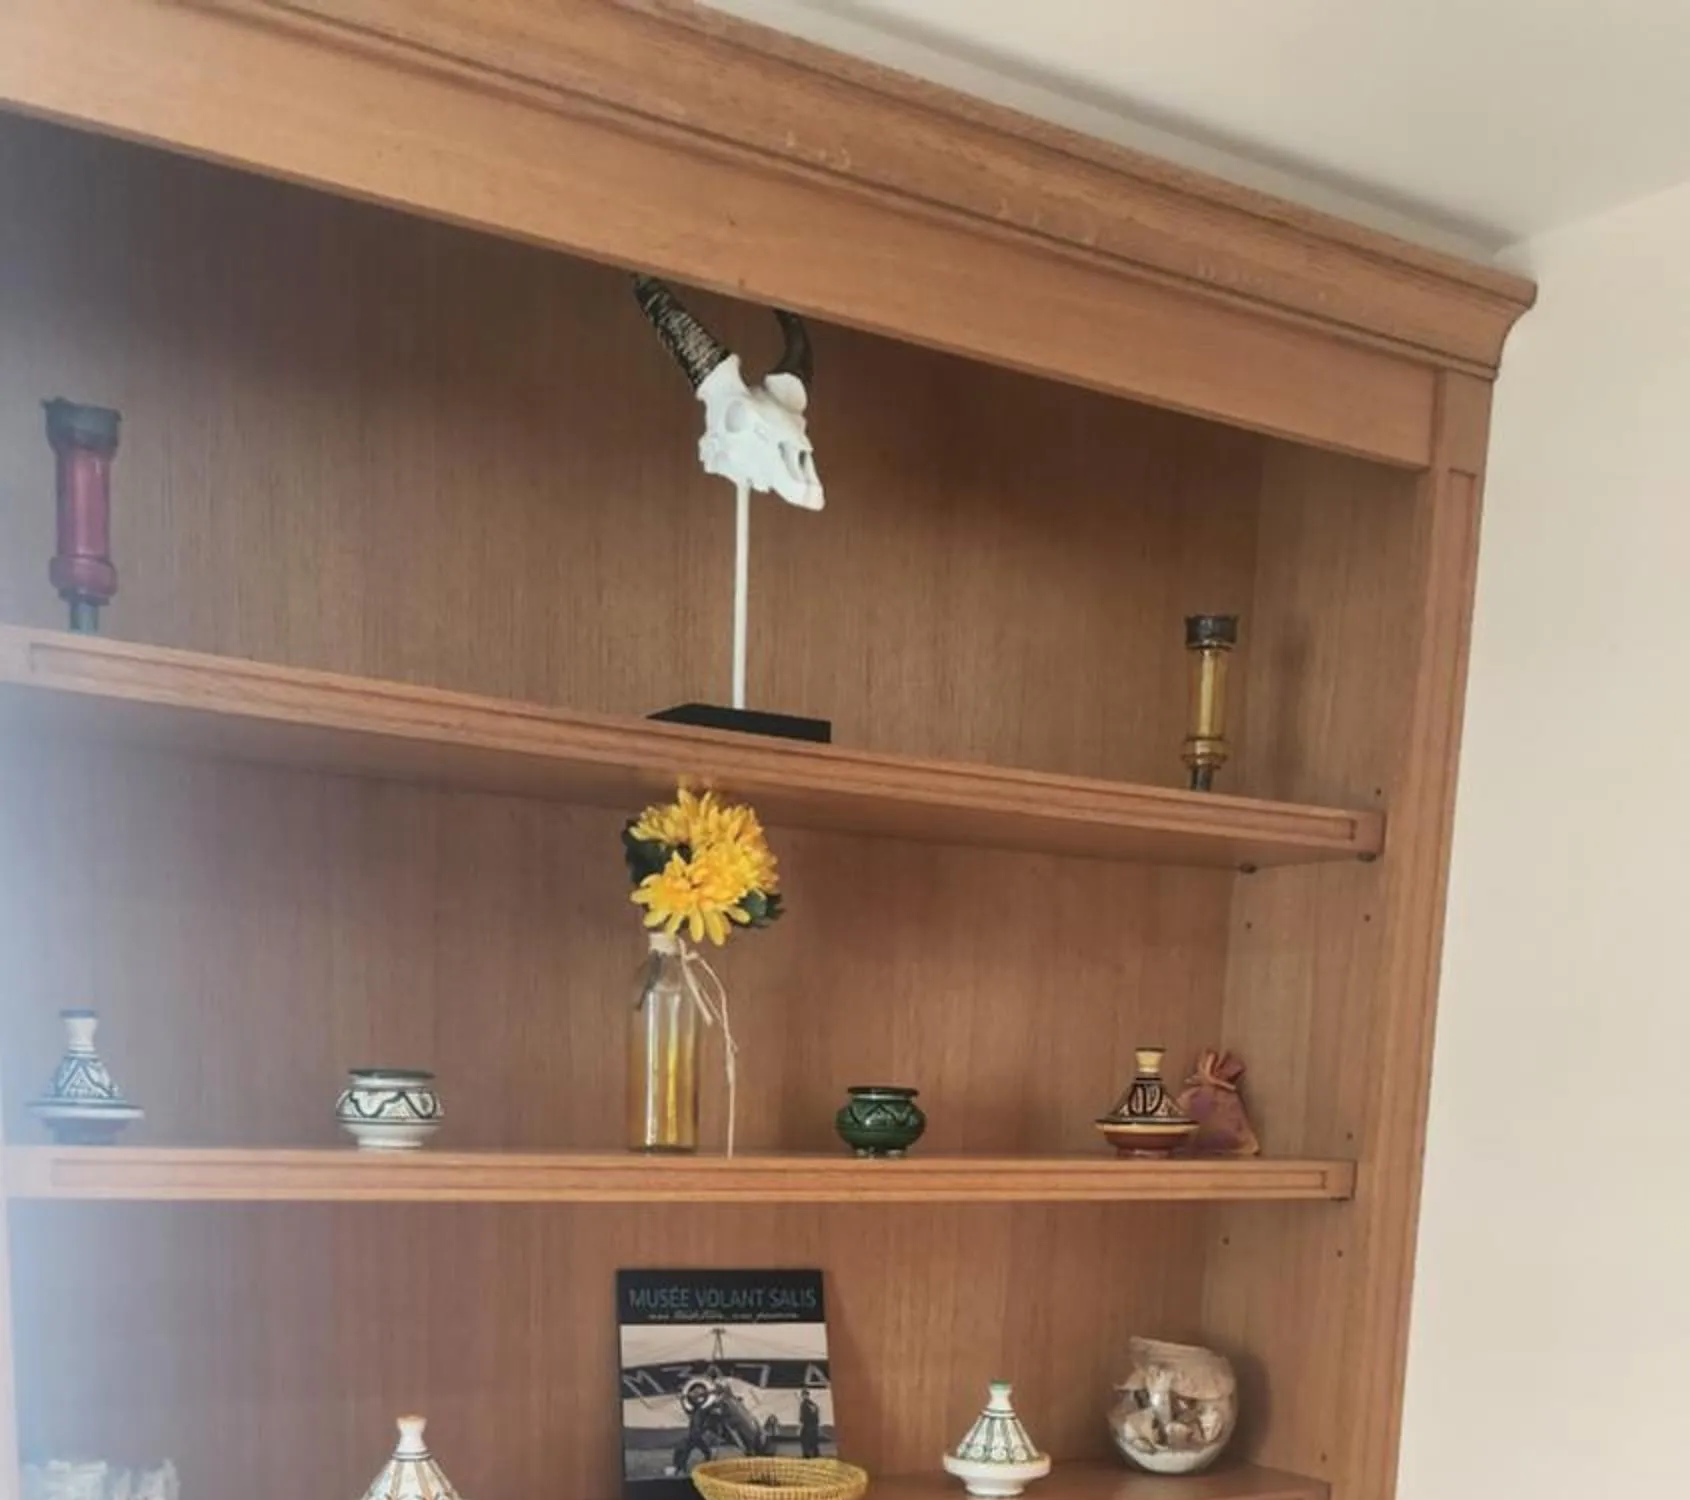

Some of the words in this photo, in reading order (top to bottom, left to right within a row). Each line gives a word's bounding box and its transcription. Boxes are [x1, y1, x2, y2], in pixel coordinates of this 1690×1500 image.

[629, 1287, 689, 1308] MUSÉE
[696, 1288, 764, 1308] VOLANT
[769, 1288, 817, 1308] SALIS
